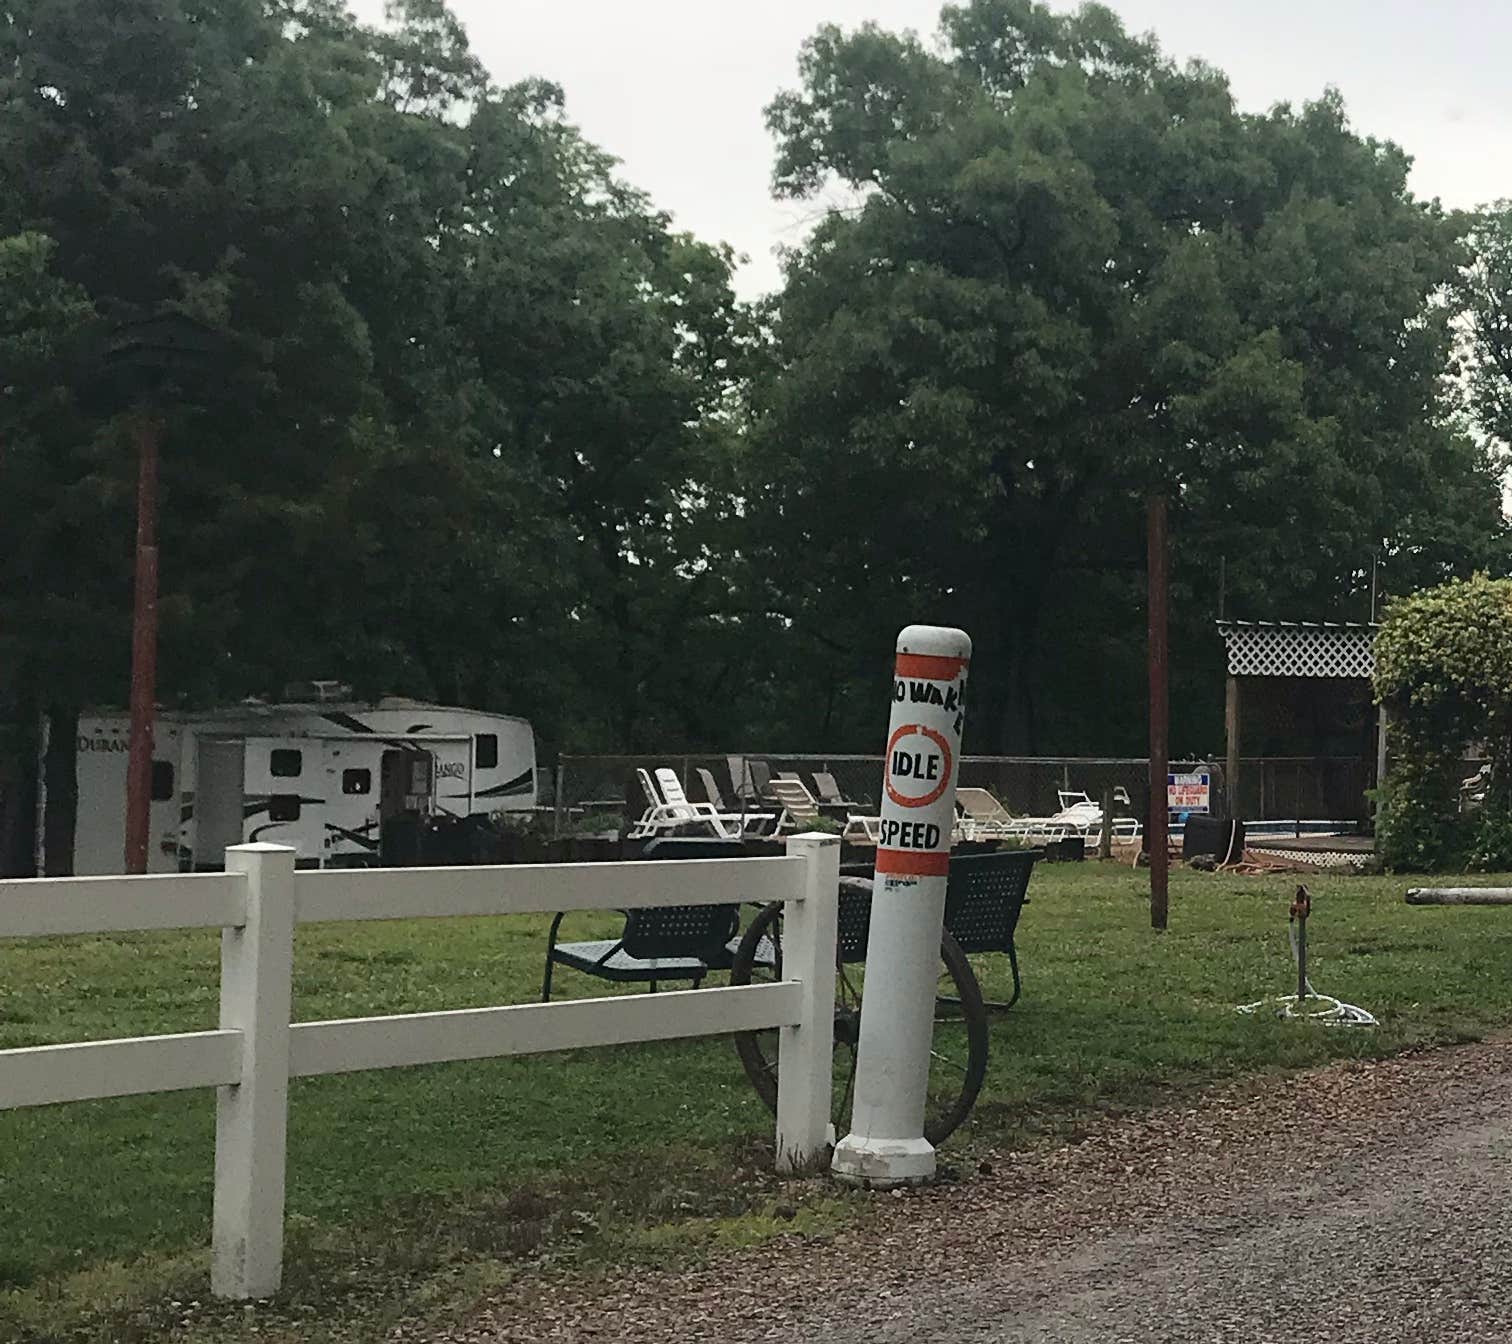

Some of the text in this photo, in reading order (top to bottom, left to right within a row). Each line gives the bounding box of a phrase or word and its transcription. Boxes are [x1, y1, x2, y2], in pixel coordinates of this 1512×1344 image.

[80, 735, 155, 753] DURAN
[892, 751, 940, 780] IDLE
[879, 819, 940, 849] SPEED
